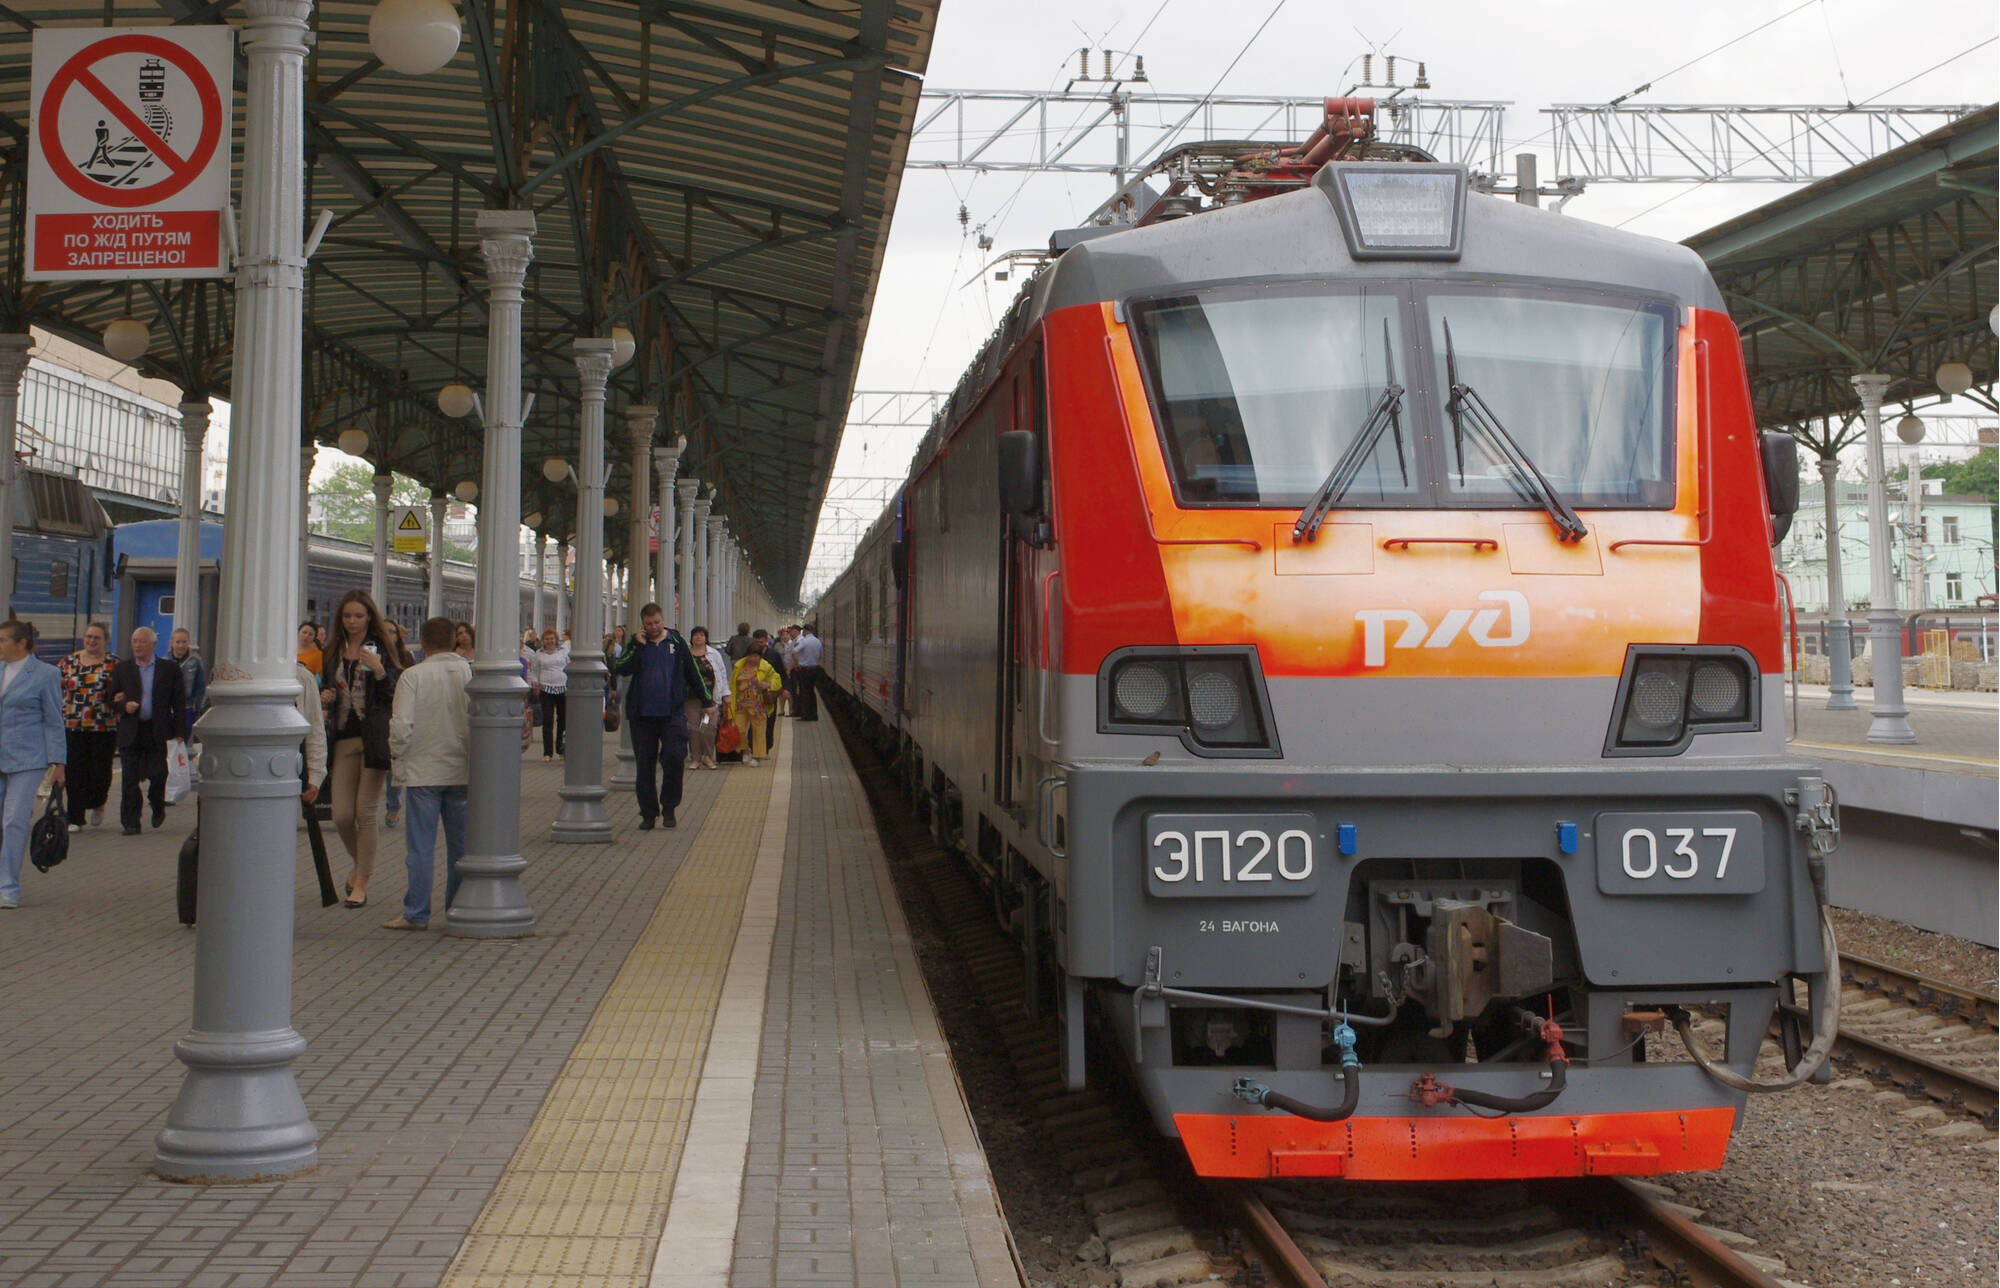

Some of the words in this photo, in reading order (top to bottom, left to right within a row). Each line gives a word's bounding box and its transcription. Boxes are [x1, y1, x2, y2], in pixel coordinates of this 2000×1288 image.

[92, 214, 164, 230] ХОДИТЬ
[64, 234, 90, 248] ПО
[94, 232, 127, 249] Ж/Д
[131, 231, 192, 247] ПУТЯМ
[67, 250, 186, 267] ЗАПРЕЩЕНО!
[1153, 830, 1313, 882] ЭП20
[1622, 828, 1737, 879] 037
[1200, 920, 1215, 932] 24
[1222, 920, 1280, 933] ВАГОНА
